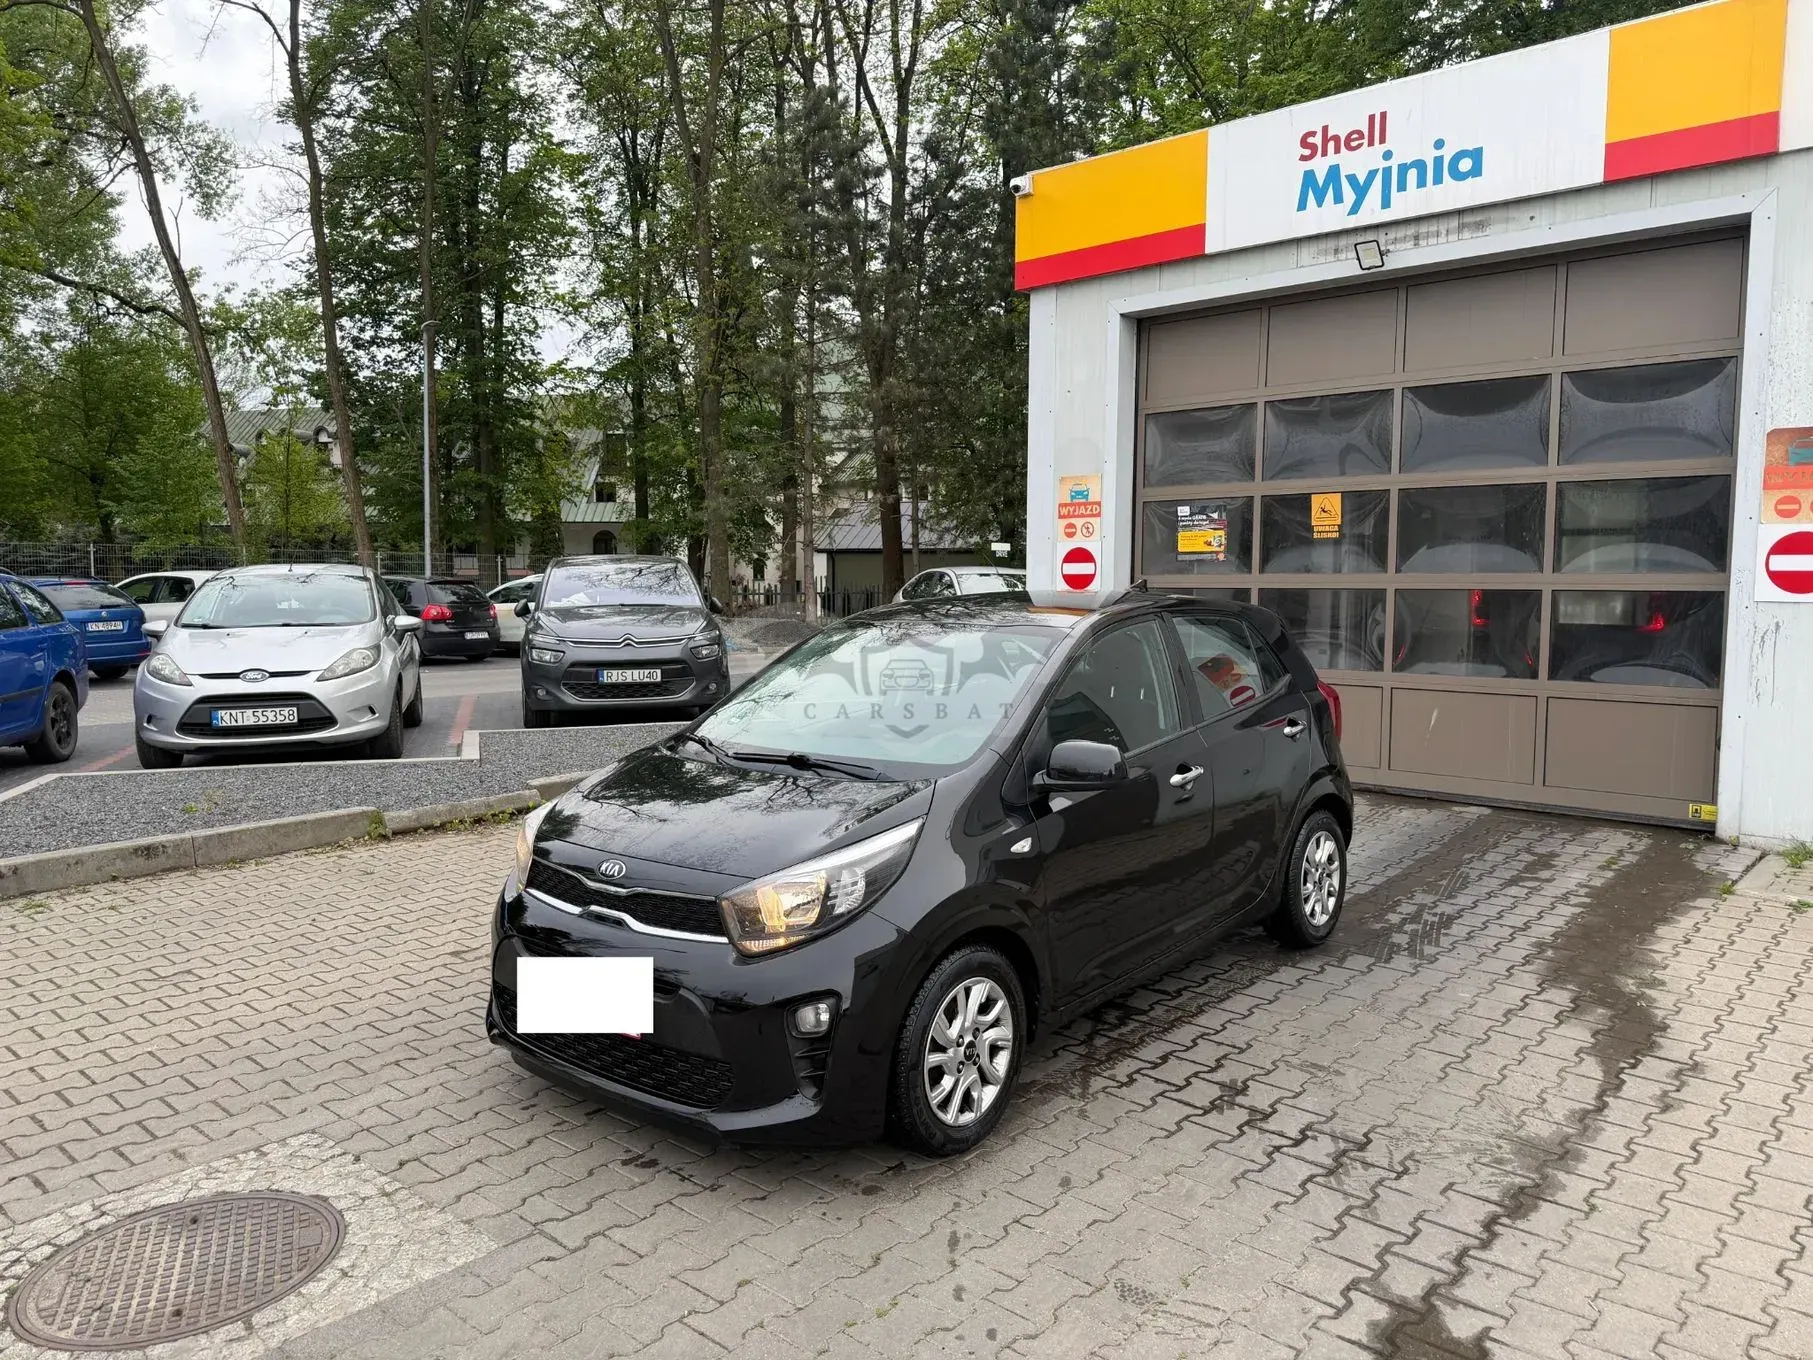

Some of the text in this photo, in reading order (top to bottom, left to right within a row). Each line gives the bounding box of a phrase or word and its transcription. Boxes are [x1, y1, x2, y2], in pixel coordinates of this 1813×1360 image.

[1298, 111, 1388, 162] Shell
[1296, 138, 1484, 216] Myjnia
[1059, 504, 1101, 517] WYJAZD
[606, 670, 658, 682] RJS LU40
[220, 708, 296, 725] KNT 55358
[600, 862, 620, 876] KIA
